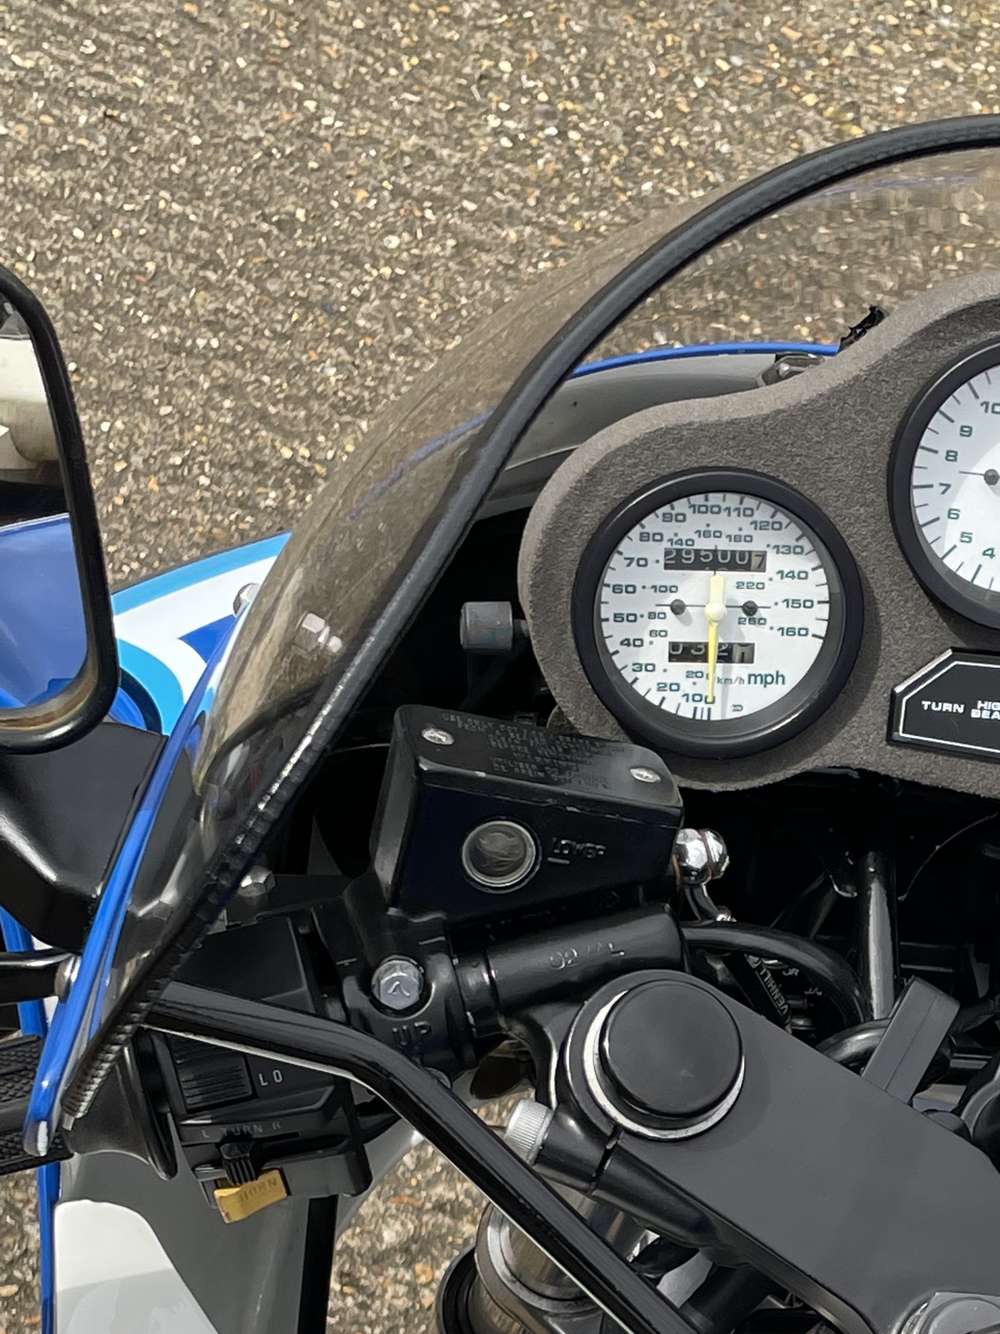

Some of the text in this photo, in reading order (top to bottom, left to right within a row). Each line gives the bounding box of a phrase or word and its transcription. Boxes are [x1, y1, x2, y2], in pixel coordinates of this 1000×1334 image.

[959, 425, 973, 438] 9
[944, 449, 958, 463] 8
[938, 482, 951, 495] 7
[688, 504, 722, 515] 100
[723, 506, 755, 518] 110
[947, 508, 960, 520] 6
[662, 512, 687, 523] 90
[750, 520, 784, 532] 120
[639, 532, 664, 543] 80
[666, 538, 696, 548] 140
[960, 531, 973, 544] 5
[772, 544, 804, 556] 130
[982, 547, 996, 560] 4
[623, 557, 649, 568] 70
[776, 569, 810, 581] 140
[612, 584, 637, 595] 60
[650, 584, 679, 594] 100
[735, 581, 766, 590] 220
[782, 598, 815, 610] 150
[613, 612, 638, 623] 50
[776, 626, 810, 638] 160
[619, 637, 645, 648] 40
[631, 662, 657, 673] 30
[747, 670, 786, 689] mph
[655, 682, 681, 693] 20
[681, 692, 704, 703] 10
[921, 700, 965, 714] TURN
[258, 1069, 284, 1087] LO
